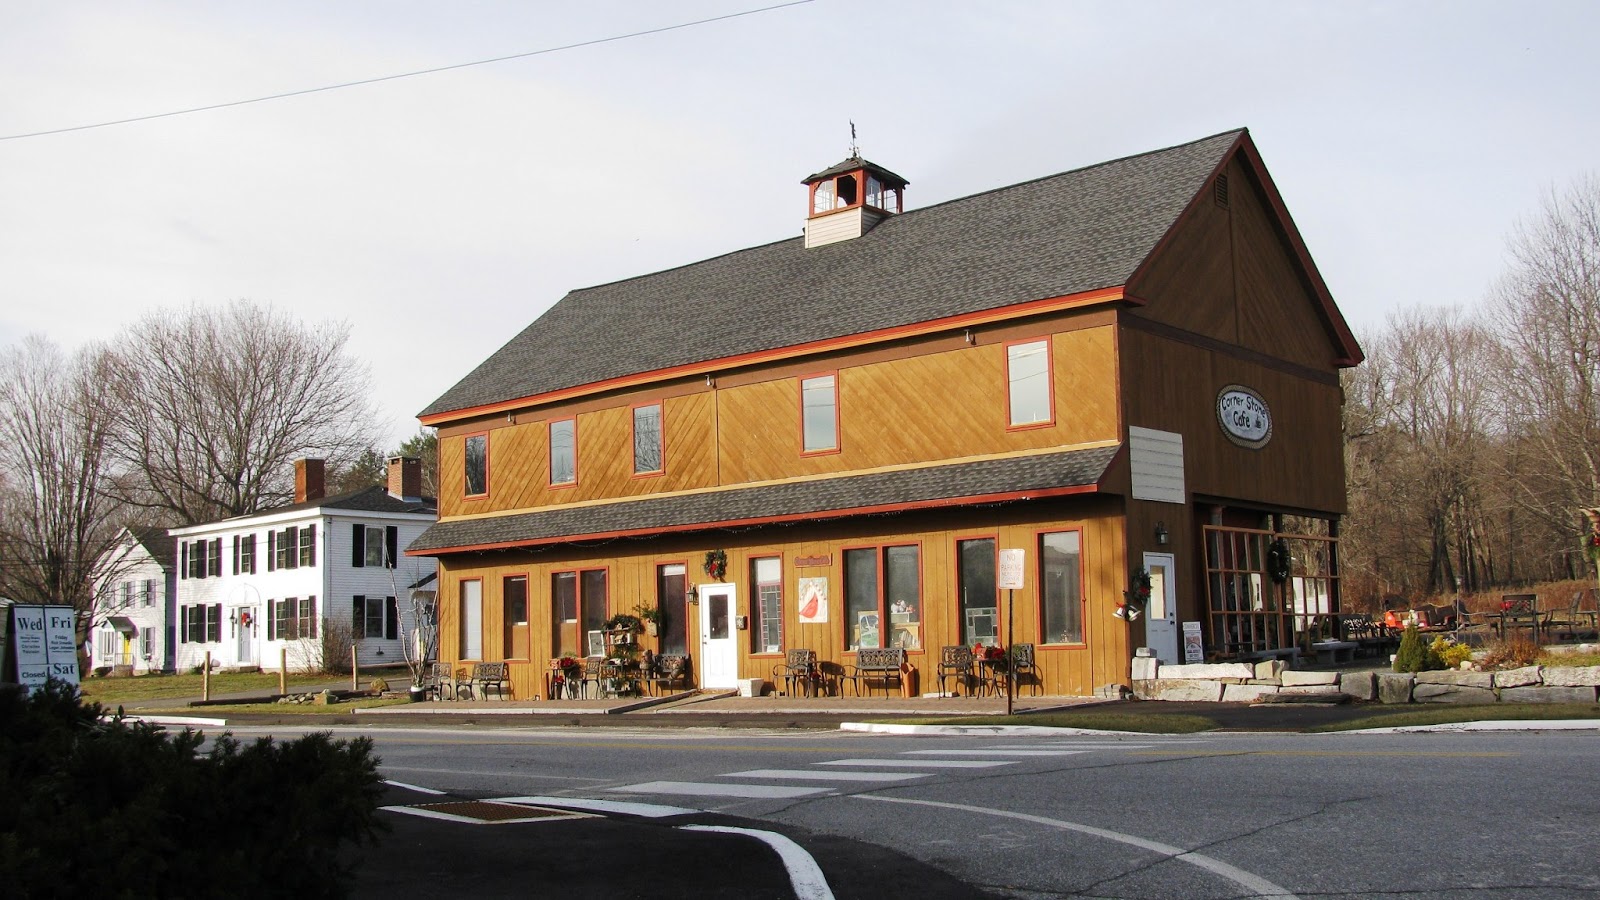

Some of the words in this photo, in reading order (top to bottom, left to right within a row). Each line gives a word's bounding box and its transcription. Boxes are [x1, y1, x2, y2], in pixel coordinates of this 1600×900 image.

[1222, 396, 1244, 411] Corner
[18, 618, 42, 630] Wed
[51, 616, 71, 628] Fri
[54, 663, 74, 674] Sat
